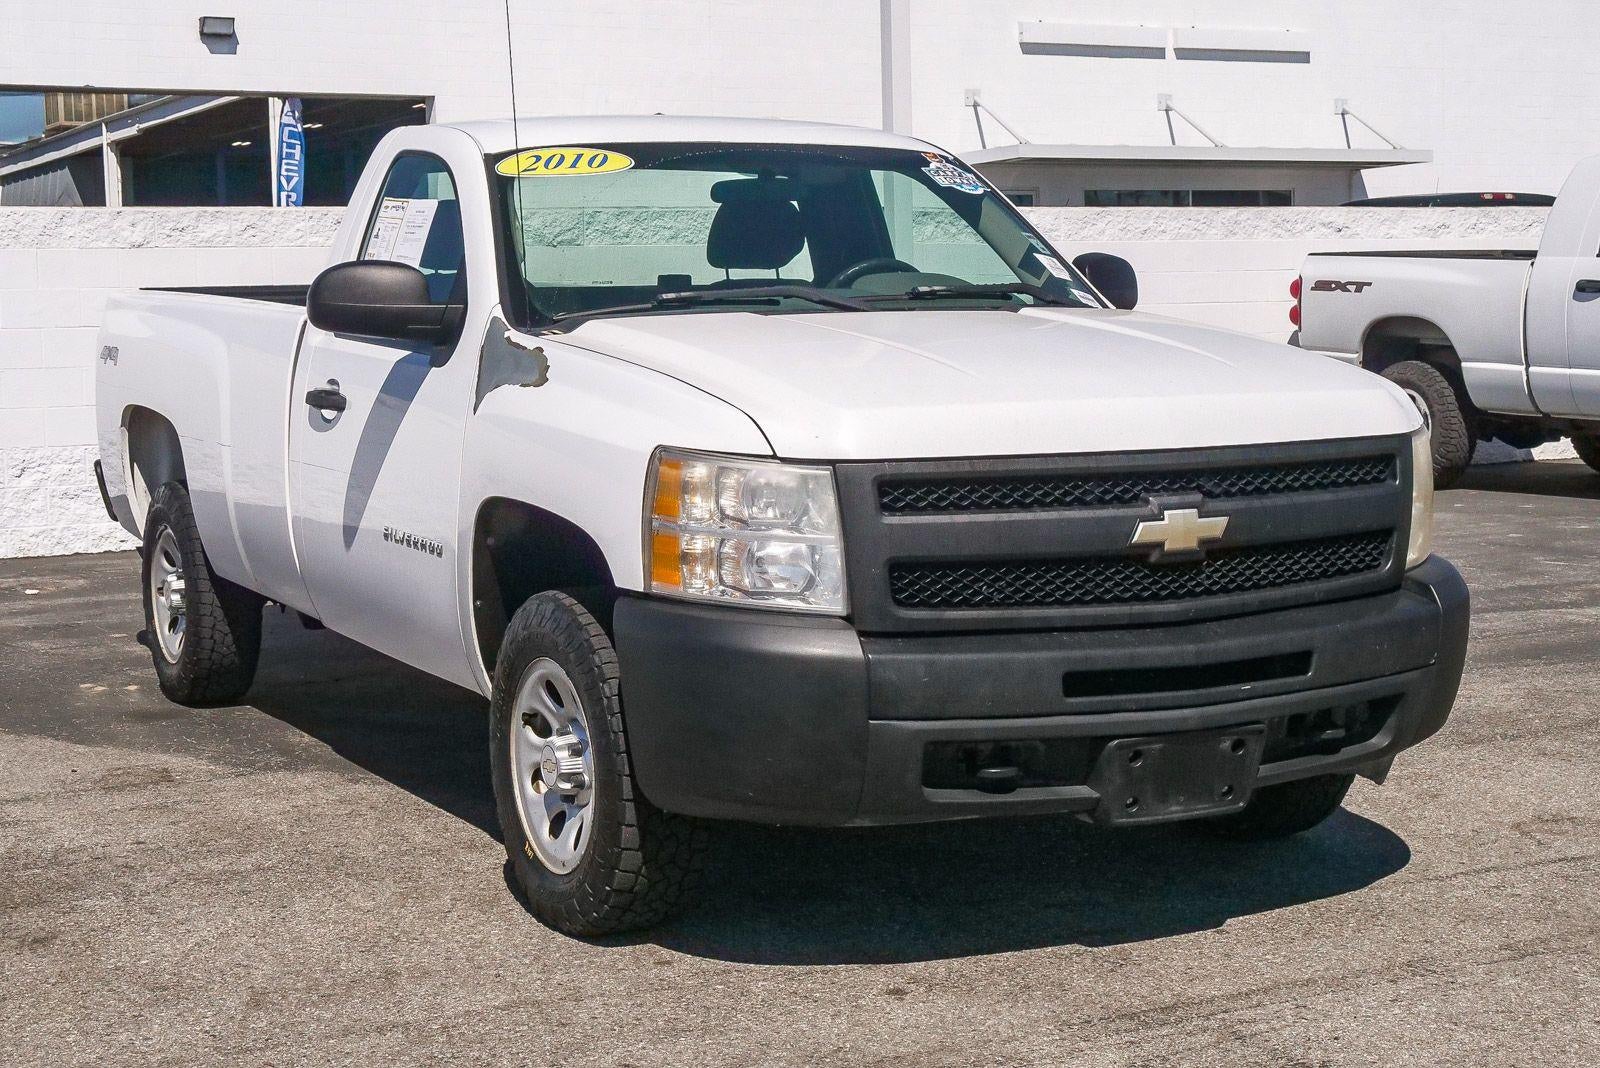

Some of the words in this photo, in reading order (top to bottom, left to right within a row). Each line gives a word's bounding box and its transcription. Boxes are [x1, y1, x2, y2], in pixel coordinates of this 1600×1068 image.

[519, 152, 609, 173] 2010
[1310, 279, 1373, 293] SXT
[383, 525, 444, 559] SILVERADO
